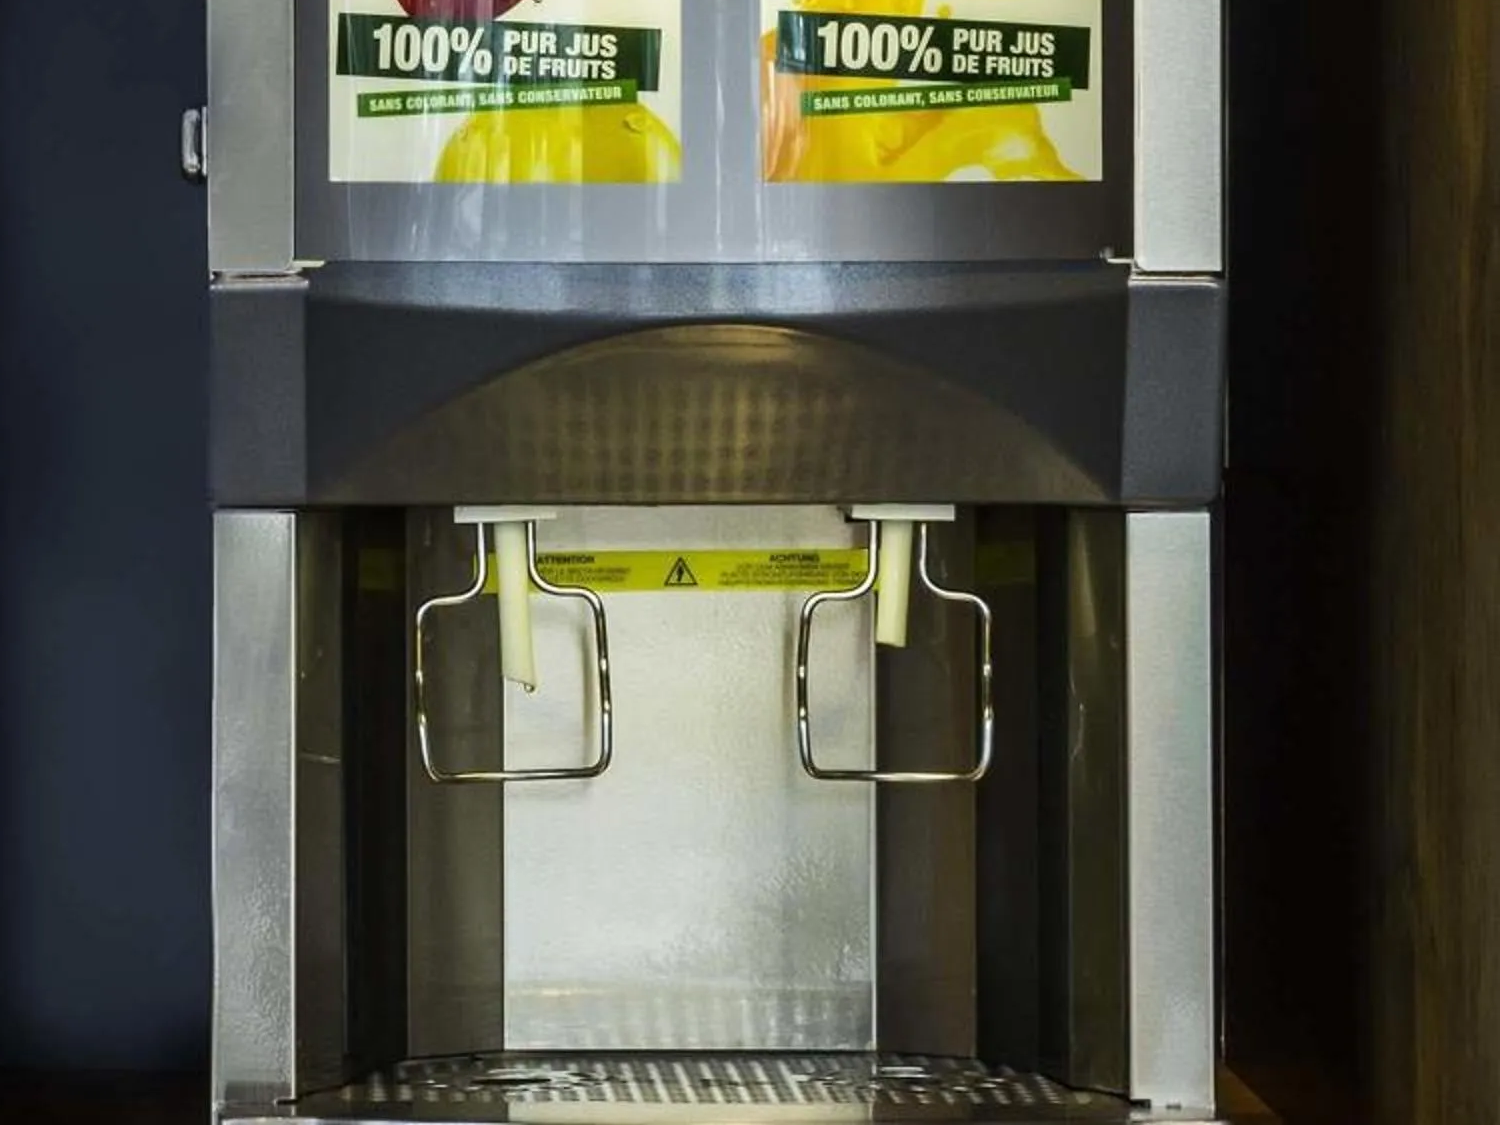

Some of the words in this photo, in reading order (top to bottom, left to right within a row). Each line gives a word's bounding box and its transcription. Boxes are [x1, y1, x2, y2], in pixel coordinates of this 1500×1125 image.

[373, 23, 492, 76] 100%
[503, 29, 558, 55] PUR
[565, 32, 618, 59] JUS
[817, 21, 942, 73] 100%
[952, 28, 1002, 53] PUR
[1010, 31, 1055, 56] JUS
[503, 56, 533, 75] DE
[539, 59, 616, 80] FRUITS
[952, 55, 979, 74] DE
[986, 57, 1054, 78] FRUITS
[369, 98, 402, 112] SANS
[479, 91, 514, 106] SANS
[518, 86, 622, 104] CONSERVATEUR
[813, 96, 850, 111] SANS
[854, 91, 926, 108] COLORANT,
[929, 89, 963, 105] SANS
[967, 84, 1059, 102] CONSERVATEUR
